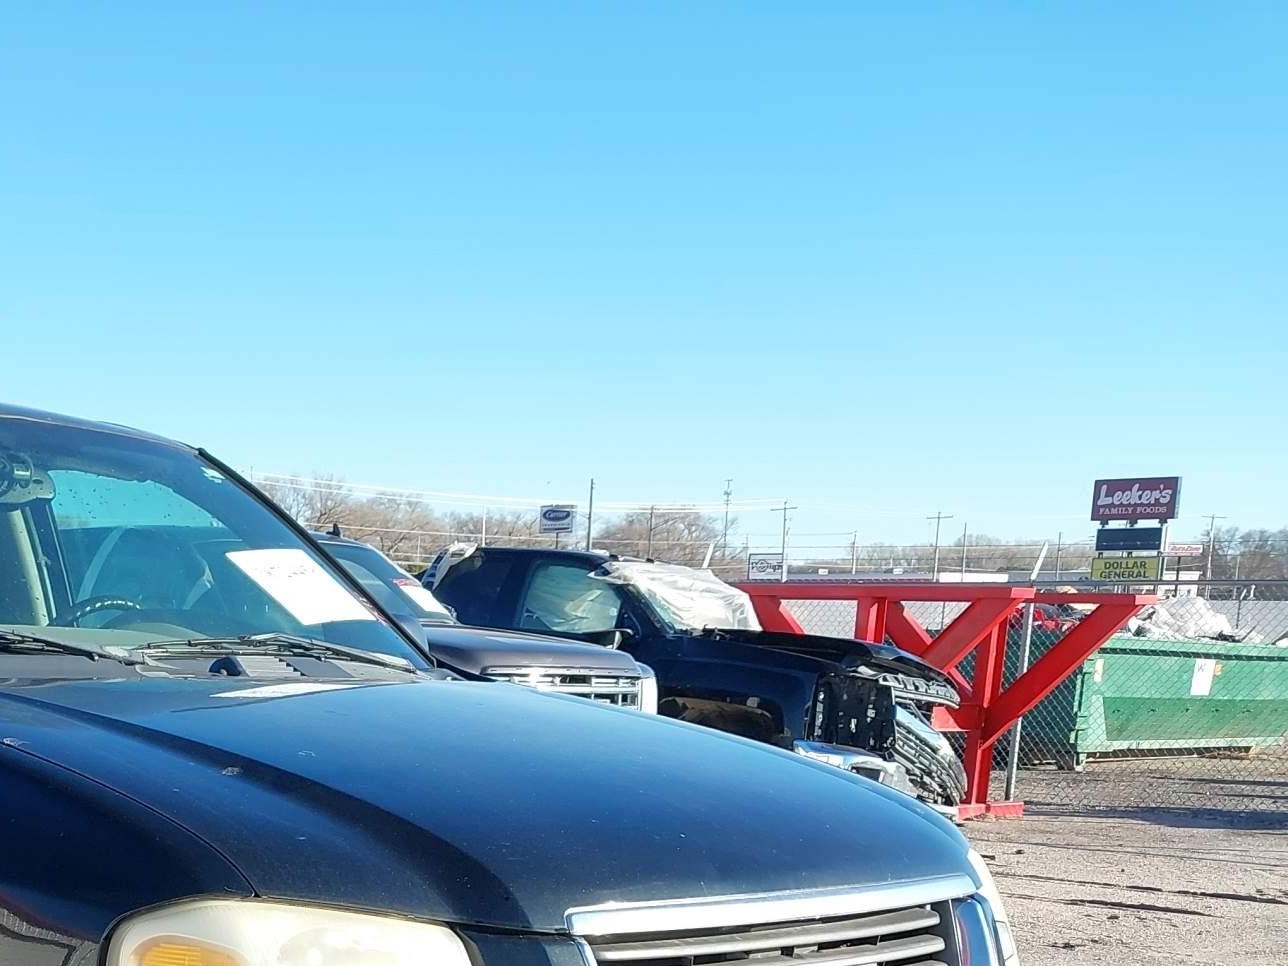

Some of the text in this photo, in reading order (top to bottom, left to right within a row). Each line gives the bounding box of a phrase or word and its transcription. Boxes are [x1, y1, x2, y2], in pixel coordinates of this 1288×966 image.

[1096, 483, 1173, 506] Leeker's
[1098, 506, 1168, 515] FAMILY FOODS
[1103, 560, 1148, 570] DOLLAR
[1099, 570, 1150, 580] GENERAL
